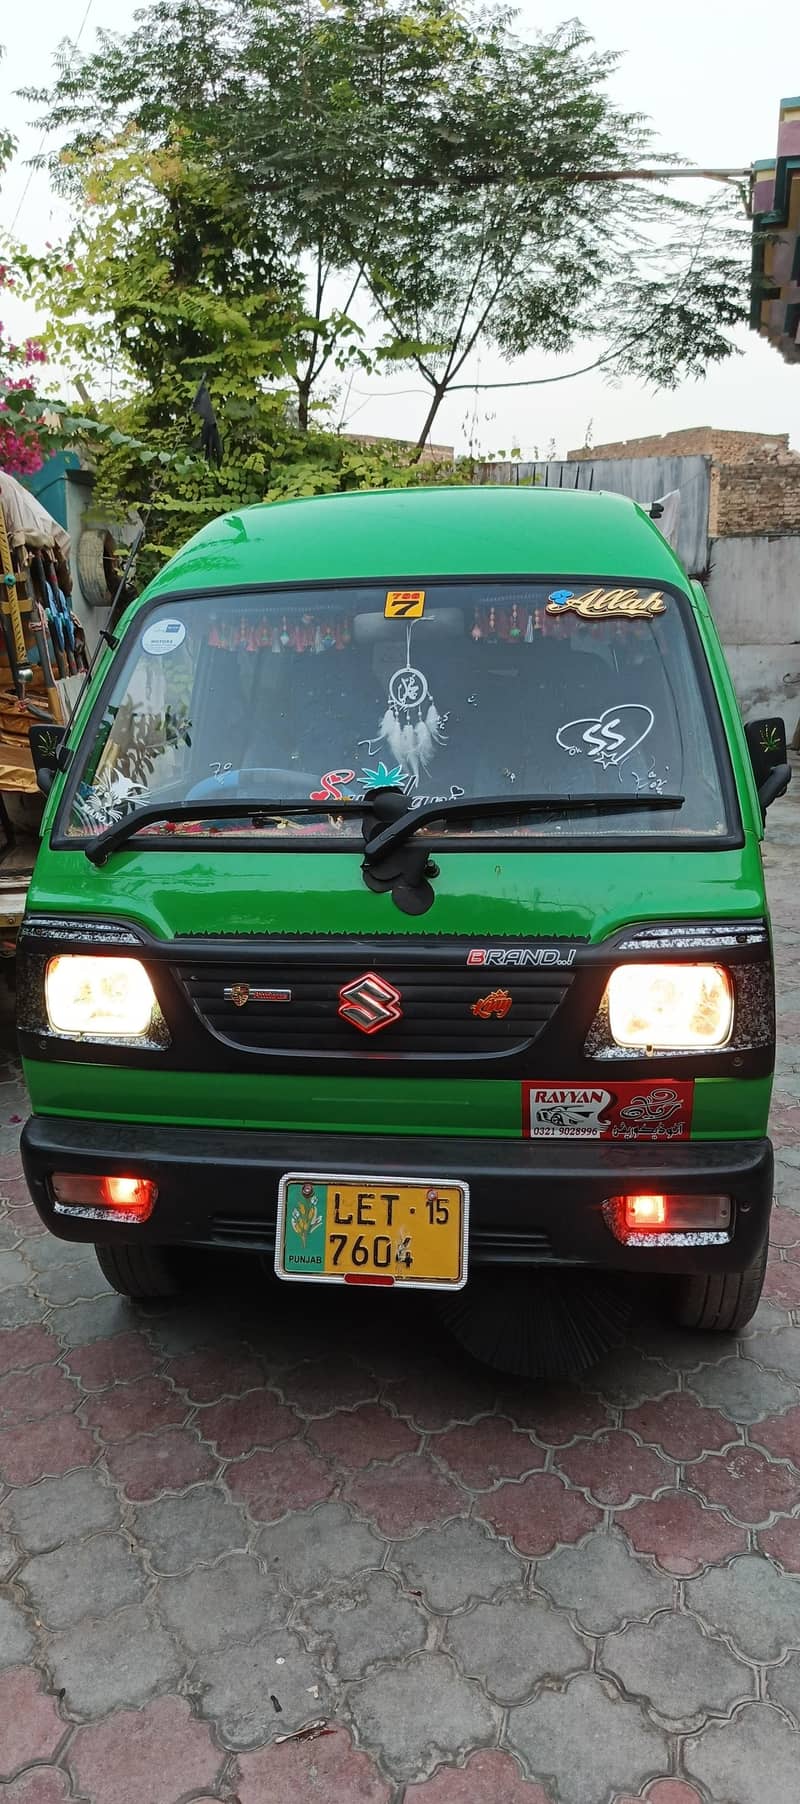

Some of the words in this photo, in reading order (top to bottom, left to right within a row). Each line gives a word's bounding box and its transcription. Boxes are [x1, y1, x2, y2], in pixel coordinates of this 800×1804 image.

[391, 600, 419, 615] 7
[546, 588, 667, 618] Allah
[534, 1090, 604, 1104] RAYYAN
[532, 1126, 556, 1137] 0321
[558, 1126, 599, 1137] 9028996
[334, 1192, 401, 1226] LET
[425, 1197, 449, 1225] 15
[329, 1233, 414, 1270] 7604
[288, 1254, 323, 1265] PUNJAB
